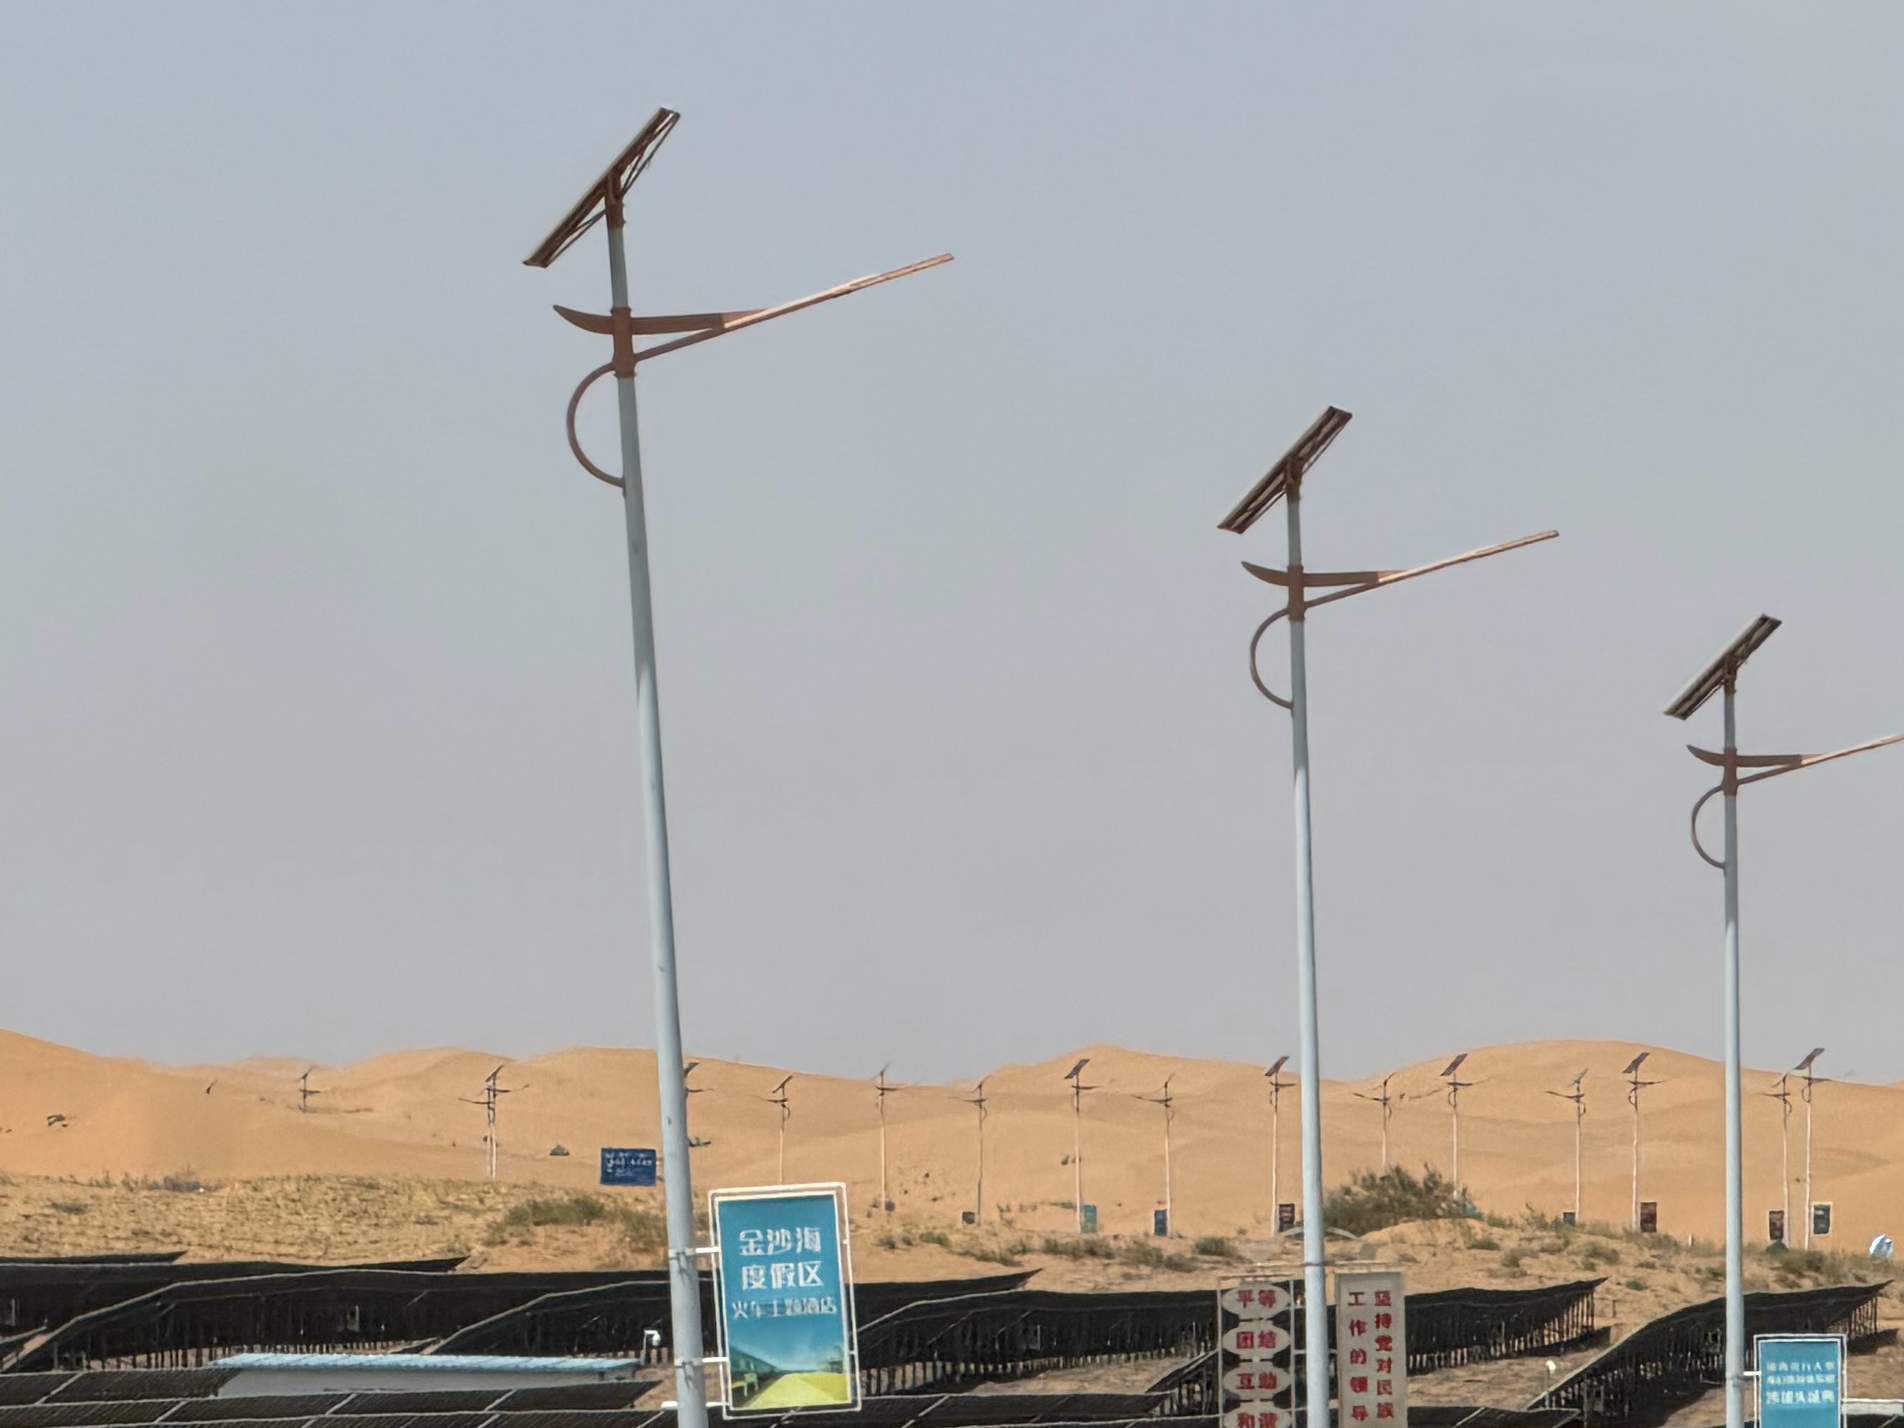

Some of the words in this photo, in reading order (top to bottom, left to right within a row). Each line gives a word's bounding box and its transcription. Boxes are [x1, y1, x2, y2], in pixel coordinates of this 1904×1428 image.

[738, 1227, 822, 1257] 金沙海
[741, 1260, 824, 1291] 度假区
[1237, 1289, 1277, 1308] 平等
[1236, 1329, 1278, 1349] 团结
[1347, 1291, 1369, 1422] 工作的领导
[1236, 1372, 1278, 1390] 互助
